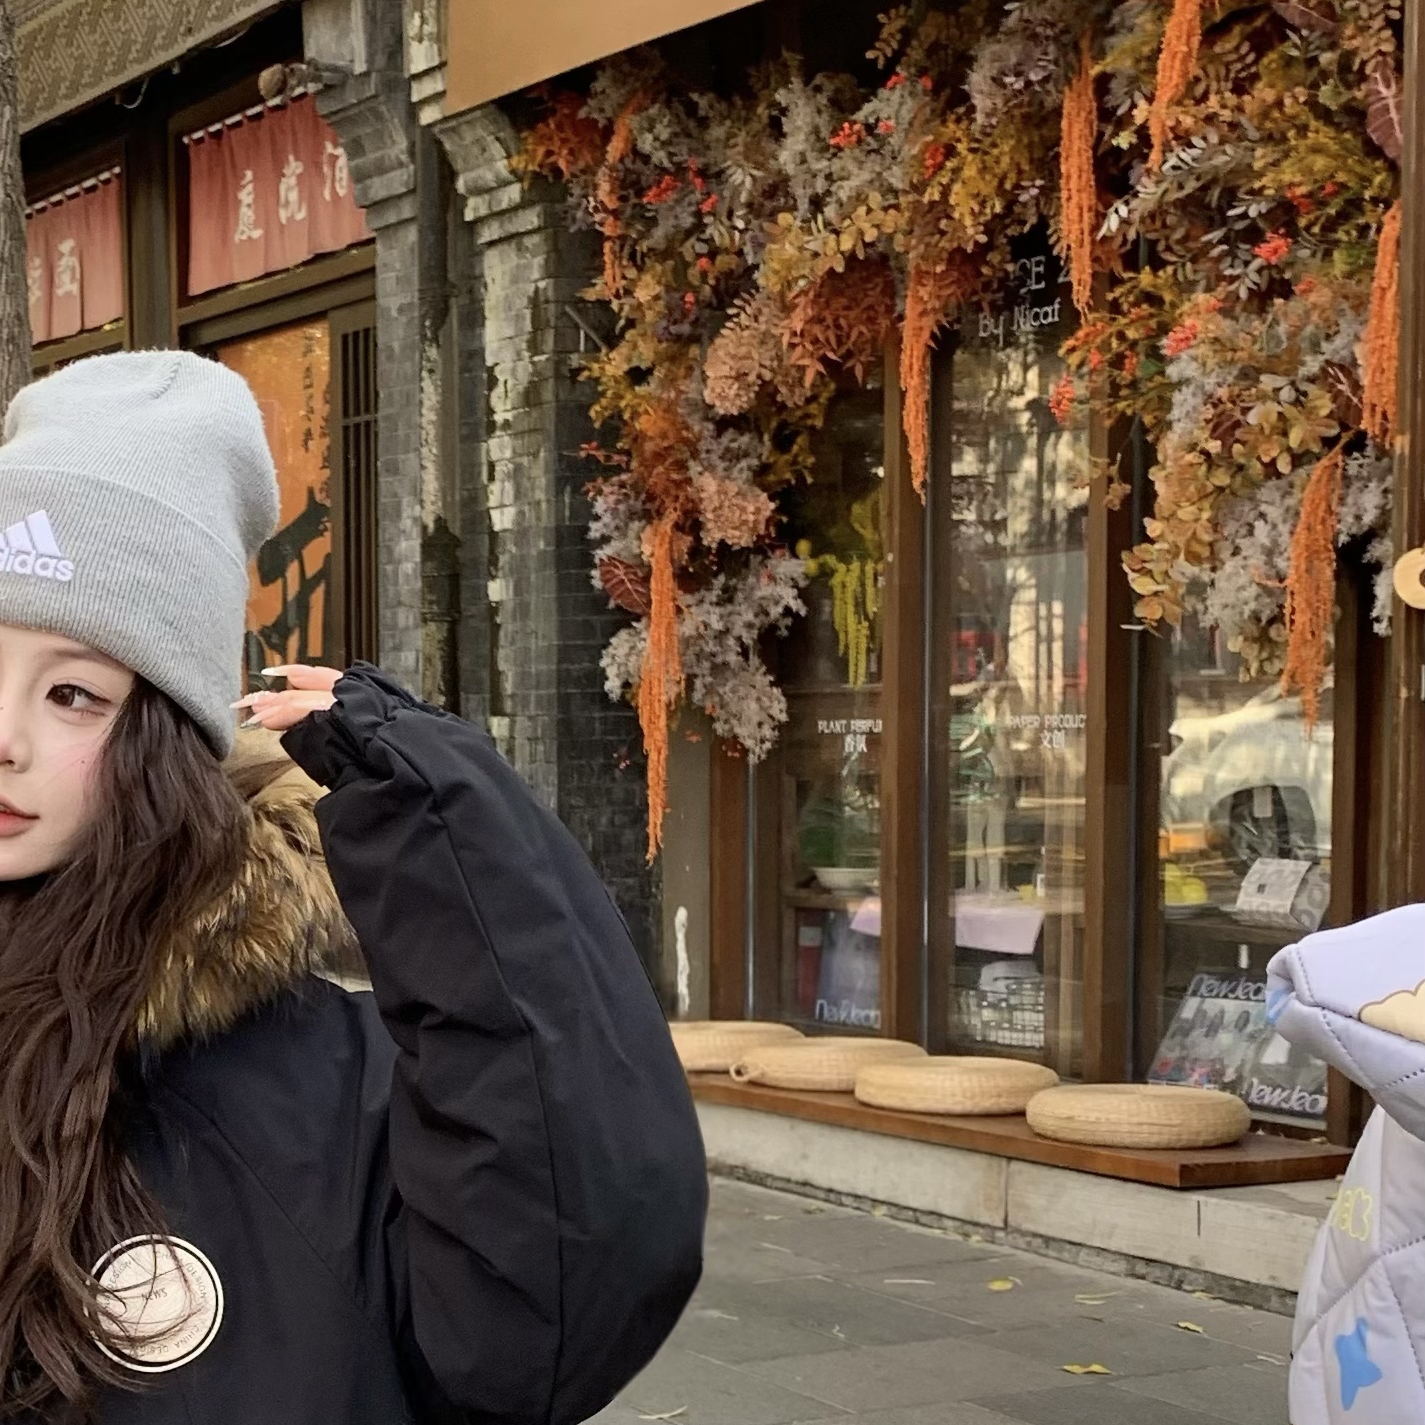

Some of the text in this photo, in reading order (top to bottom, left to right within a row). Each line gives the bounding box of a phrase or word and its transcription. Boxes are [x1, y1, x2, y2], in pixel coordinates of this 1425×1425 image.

[817, 719, 883, 734] PLANT PERFU
[1045, 713, 1087, 729] PRODUC
